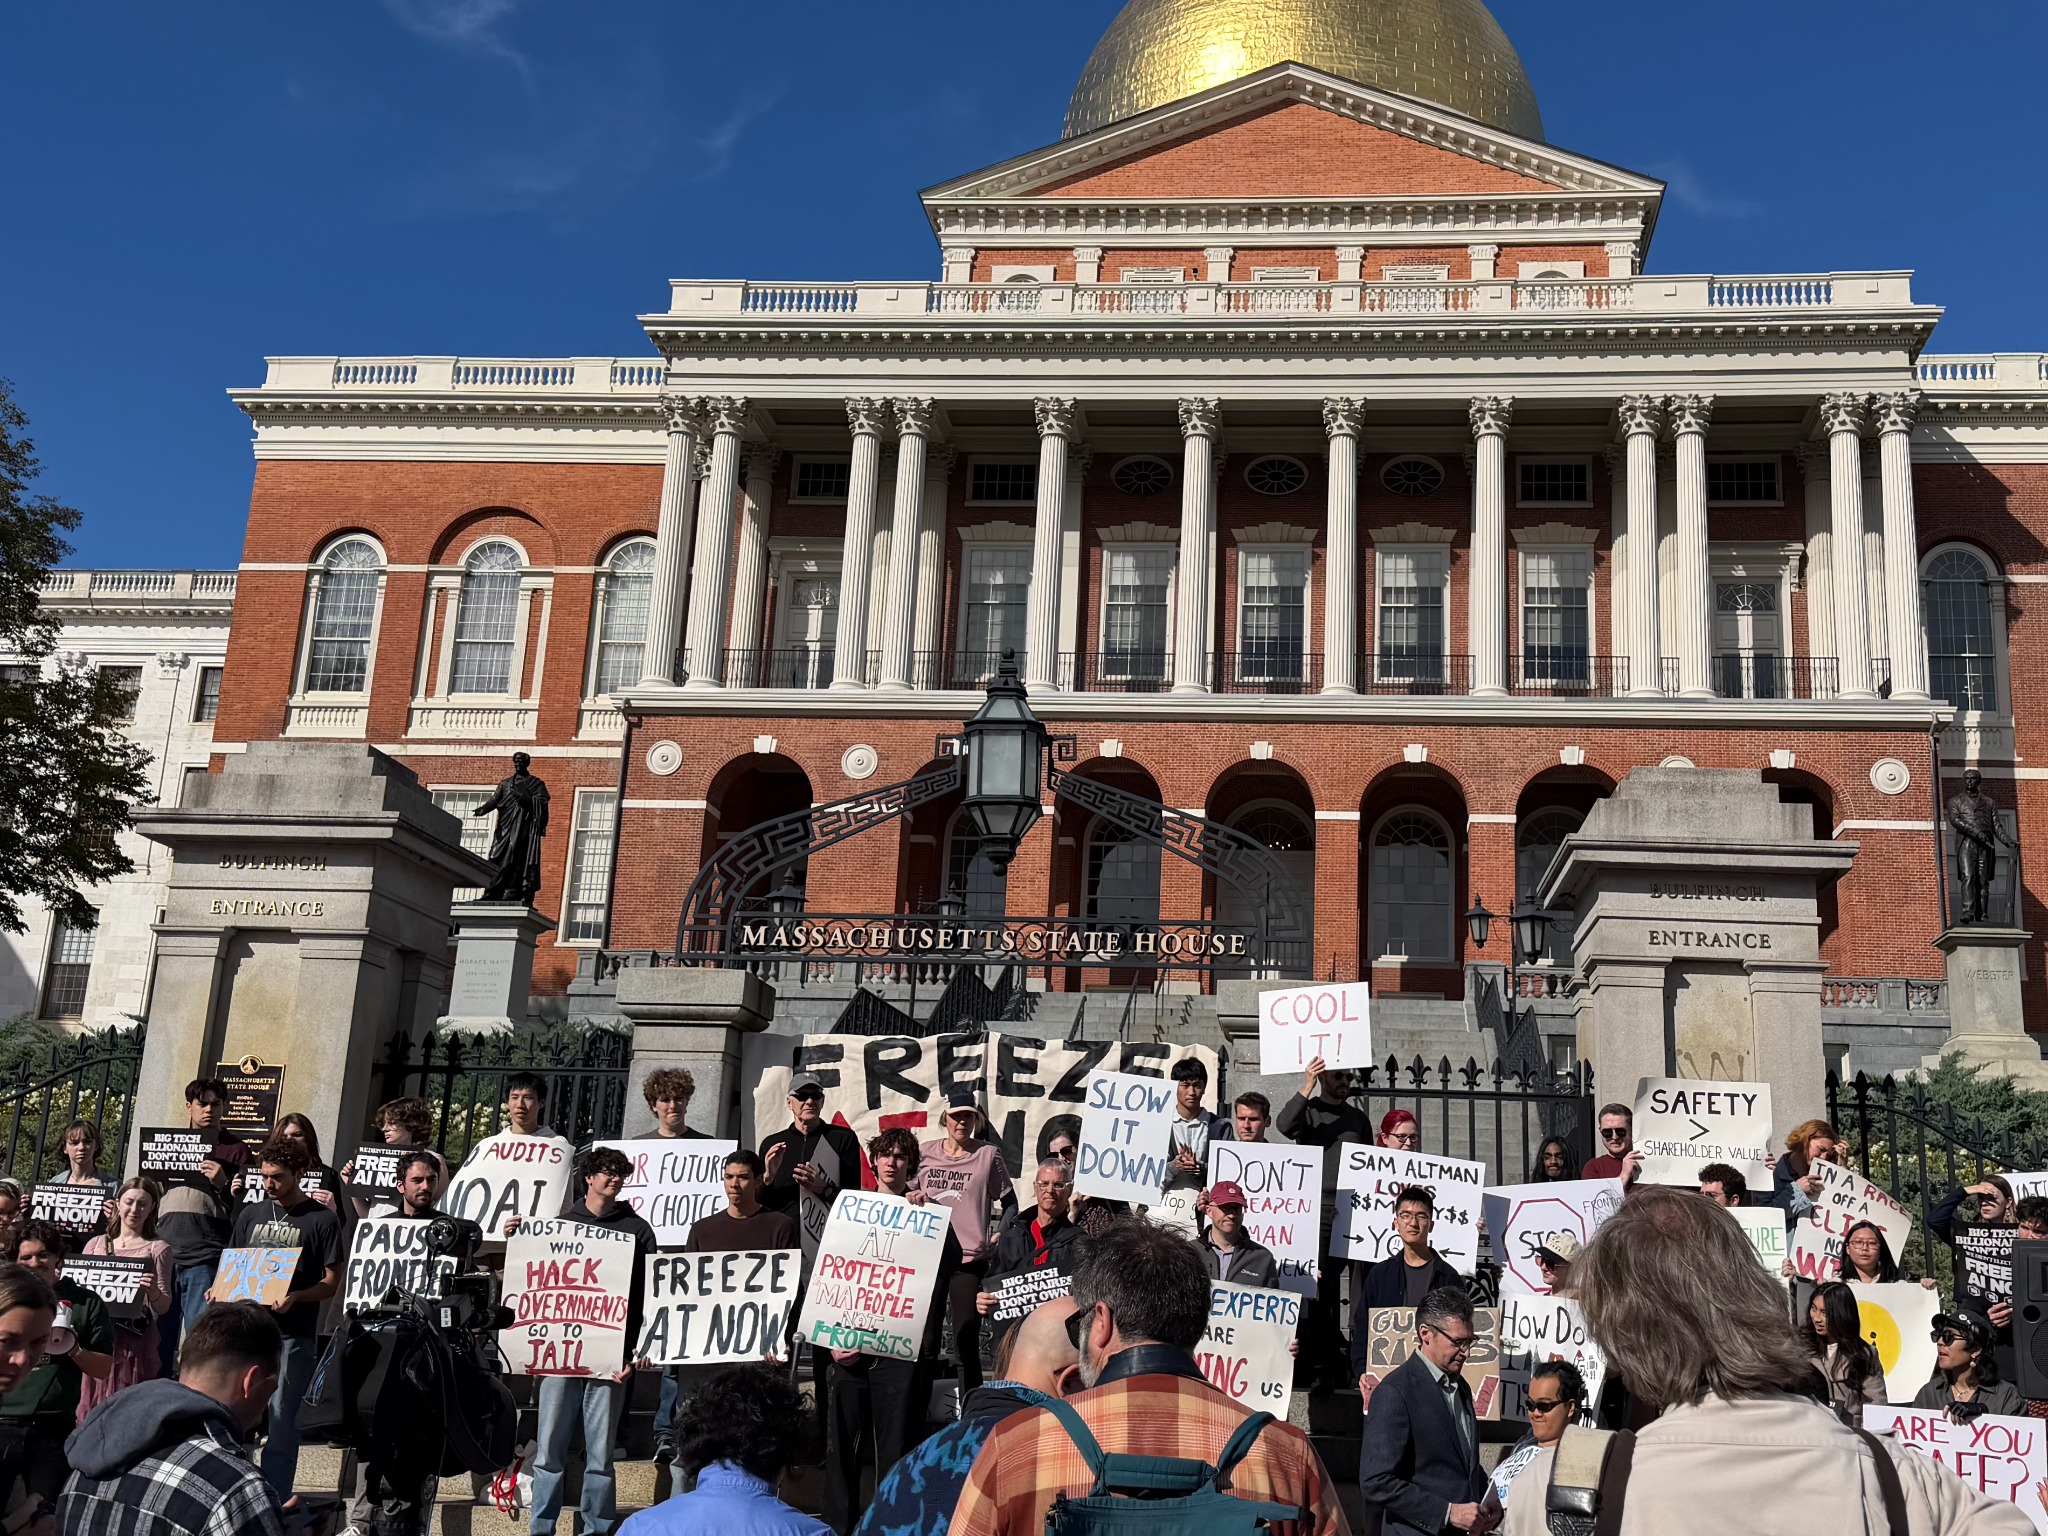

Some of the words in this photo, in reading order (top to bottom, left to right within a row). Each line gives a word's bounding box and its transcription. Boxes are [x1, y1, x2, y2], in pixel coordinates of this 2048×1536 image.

[219, 854, 327, 871] BULFINCH
[1649, 883, 1766, 902] BULFINCH
[209, 899, 324, 916] ENTRANCE
[740, 925, 1016, 951] MASSACHUSETTS
[1028, 930, 1121, 953] STATE
[1134, 932, 1246, 955] HOUSE
[1648, 930, 1771, 949] ENTRANCE
[1963, 968, 2014, 981] WEBSTER
[1270, 990, 1359, 1026] COOL
[1298, 1033, 1342, 1064] IT!
[1089, 1078, 1172, 1113] SLOW
[1650, 1089, 1757, 1116] SAFETY
[154, 1133, 171, 1142] BIG
[173, 1134, 201, 1143] TECH
[1110, 1117, 1140, 1145] IT
[142, 1142, 212, 1153] BILLIONAIRES
[147, 1152, 178, 1161] DON'T
[180, 1153, 204, 1162] OWN
[483, 1142, 565, 1164] AUDITS
[1643, 1140, 1722, 1159] SHAREHOLDER
[1728, 1147, 1762, 1161] VALUE
[141, 1161, 163, 1170] OUR
[355, 1155, 400, 1172] FREE
[928, 1168, 946, 1178] JUST
[948, 1171, 973, 1182] DON'T
[1078, 1143, 1166, 1188] DOWN
[1215, 1147, 1313, 1193] DON'T
[1349, 1151, 1396, 1175] SAM
[1405, 1158, 1478, 1185] ALTMAN
[352, 1170, 373, 1185] AI
[375, 1172, 398, 1187] NO
[926, 1179, 948, 1189] BUILD
[1816, 1162, 1838, 1184] IN
[1841, 1175, 1855, 1191] A
[1863, 1184, 1908, 1218] RACE
[31, 1192, 104, 1209] FREEZE
[487, 1179, 548, 1235] AI
[1832, 1192, 1856, 1209] OFF
[1859, 1202, 1868, 1215] A
[31, 1206, 50, 1220] AI
[54, 1208, 100, 1223] NOW
[836, 1195, 943, 1240] REGULATE
[355, 1222, 427, 1256] PAUS
[515, 1220, 566, 1236] MOST
[574, 1223, 631, 1242] PEOPLE
[1248, 1223, 1294, 1246] MAN
[1968, 1228, 1989, 1237] BIG
[1990, 1228, 2019, 1238] TECH
[550, 1242, 584, 1255] WHO
[857, 1227, 900, 1263] AI
[220, 1249, 298, 1283] PAUSE
[526, 1258, 603, 1289] HACK
[653, 1252, 790, 1298] FREEZE
[819, 1253, 916, 1294] PROTECT
[1001, 1275, 1024, 1288] BIG
[1025, 1267, 1059, 1282] TECH
[1965, 1257, 2012, 1280] FREE
[60, 1268, 142, 1288] FREEZE
[228, 1275, 273, 1302] AI
[1968, 1272, 1986, 1288] AI
[1990, 1278, 2012, 1295] NO
[502, 1292, 627, 1323] GOVERNMENTS
[816, 1282, 852, 1310] MA
[854, 1287, 915, 1319] PEOPLE
[999, 1293, 1037, 1309] DON'T
[1039, 1287, 1070, 1301] OWN
[1210, 1288, 1299, 1325] EXPERTS
[842, 1311, 885, 1329] NOT
[993, 1307, 1022, 1321] OUR
[528, 1323, 548, 1337] GO
[563, 1323, 583, 1338] TO
[638, 1304, 698, 1361] AI
[703, 1300, 792, 1357] NOW
[811, 1320, 913, 1359] PROF$TS
[1200, 1325, 1235, 1345] ARE
[525, 1339, 590, 1370] JAIL
[1260, 1382, 1283, 1399] US
[1891, 1415, 1949, 1444] ARE
[1969, 1422, 2033, 1457] YOU
